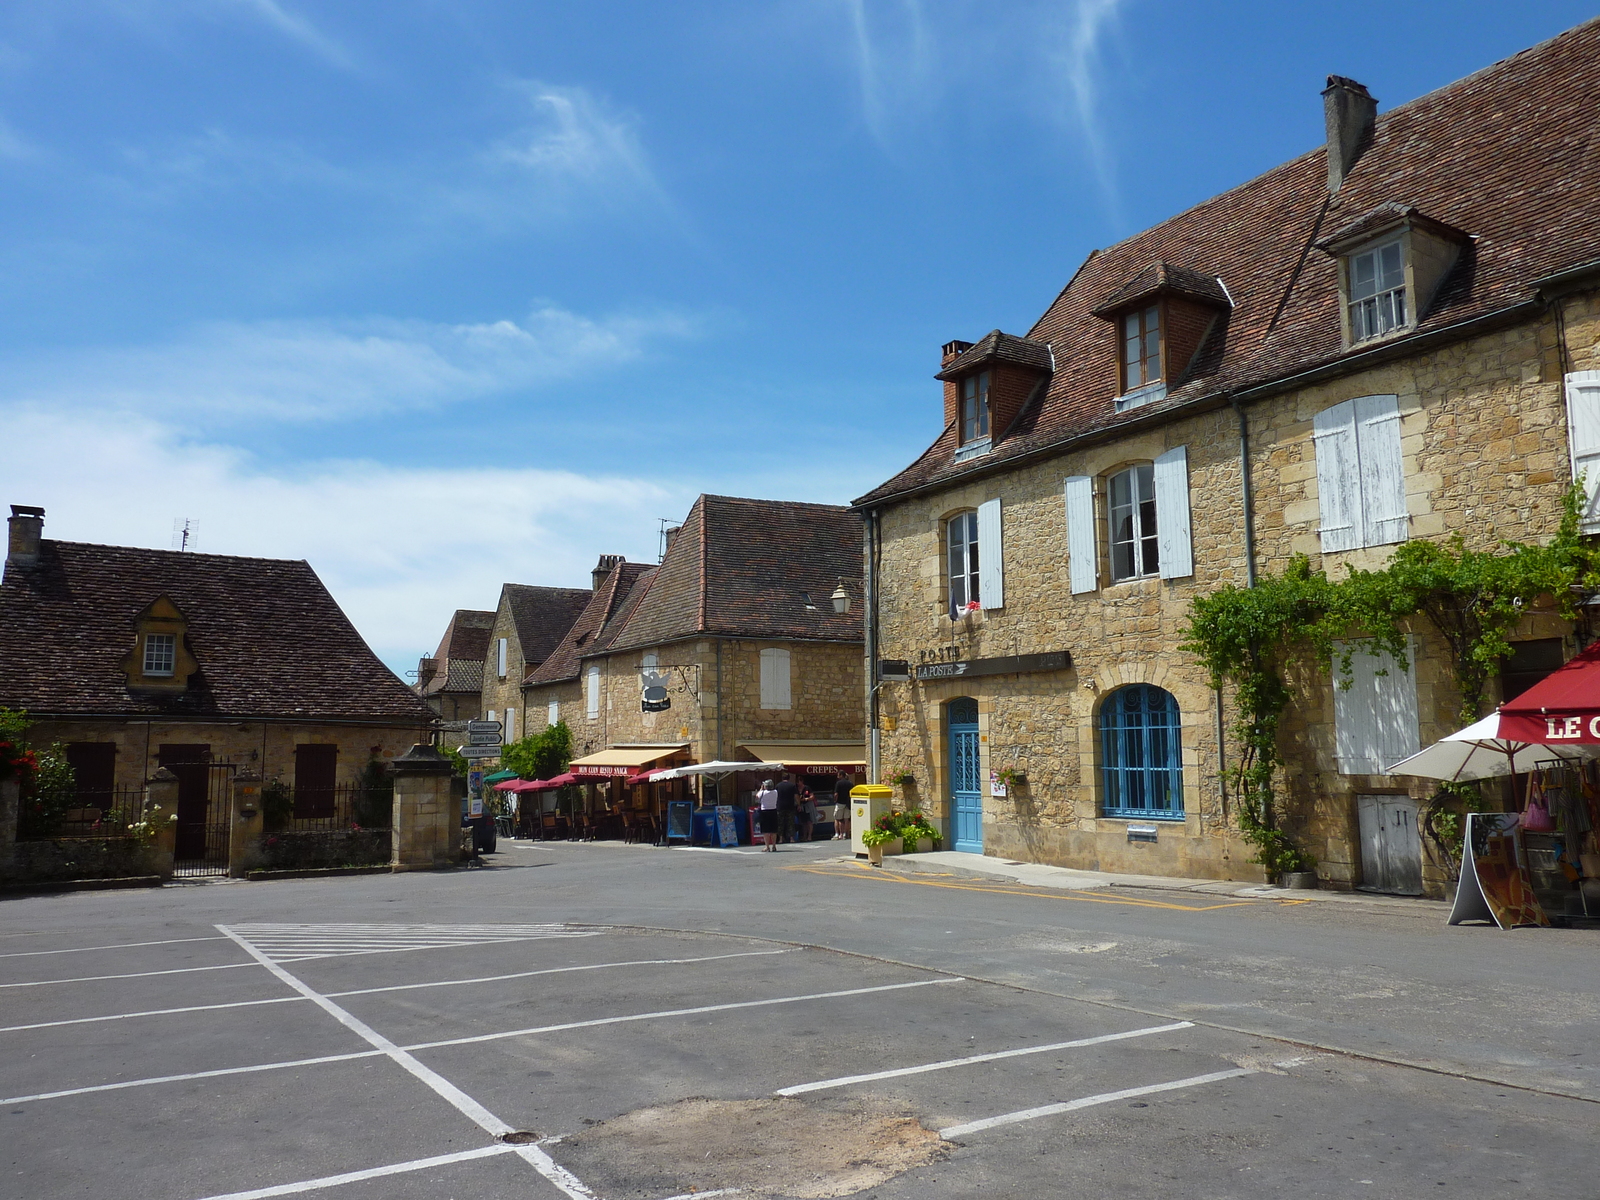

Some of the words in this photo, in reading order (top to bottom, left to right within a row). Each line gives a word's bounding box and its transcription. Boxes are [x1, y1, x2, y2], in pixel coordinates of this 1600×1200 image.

[920, 646, 960, 662] POSTE
[917, 667, 928, 678] LA
[929, 664, 954, 677] POSTE
[1545, 716, 1581, 739] LE
[588, 766, 599, 774] COIN
[599, 766, 613, 774] RESTO
[613, 766, 628, 775] SNACK
[806, 765, 839, 774] CREPES
